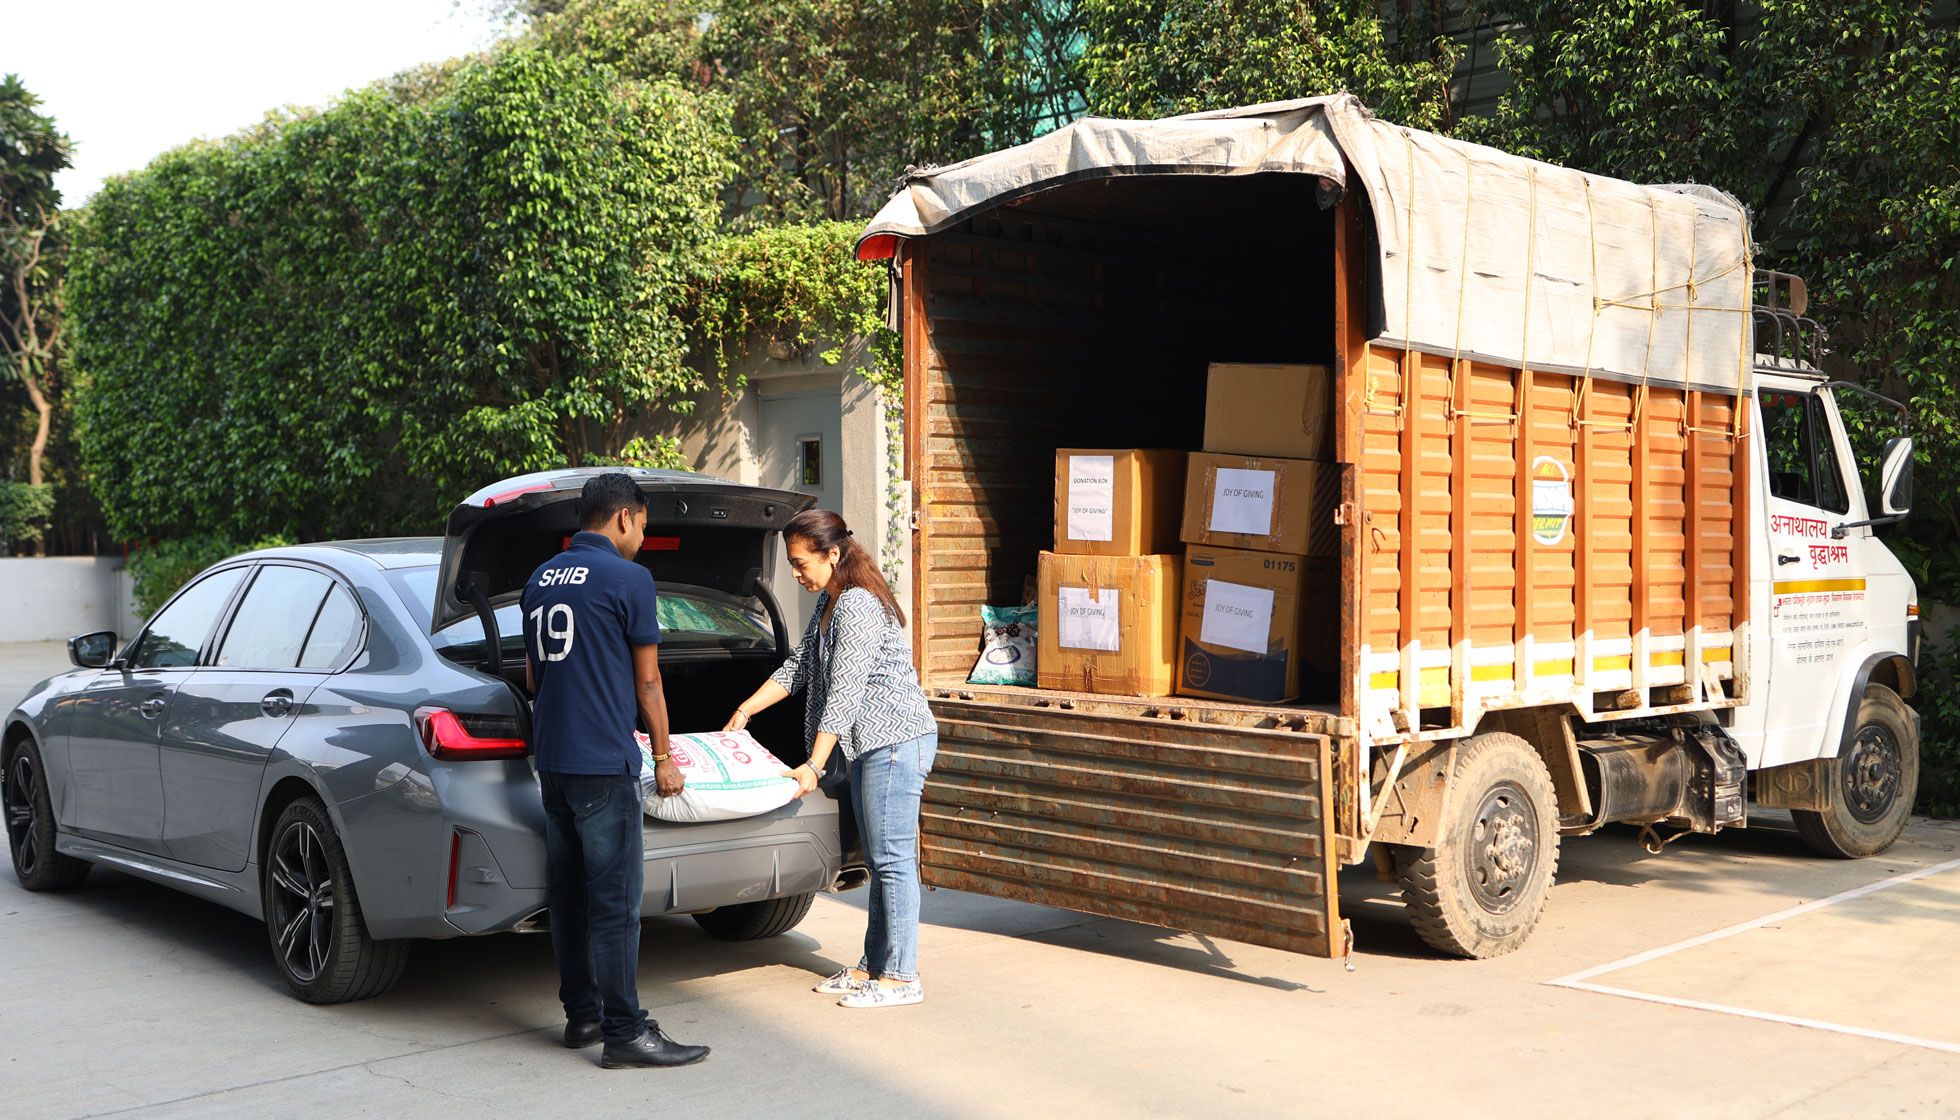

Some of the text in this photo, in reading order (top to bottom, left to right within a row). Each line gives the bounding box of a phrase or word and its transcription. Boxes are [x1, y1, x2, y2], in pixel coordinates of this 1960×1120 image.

[1223, 488, 1264, 499] JOY OF GIVING
[1533, 517, 1563, 530] ERMIT
[1771, 514, 1827, 538] अनाथालय
[1263, 559, 1296, 572] 01175
[1808, 545, 1848, 570] वृद्धाश्रम
[538, 566, 590, 587] SHIB
[1070, 607, 1105, 617] JOY OF GIVING
[1214, 603, 1225, 612] JOY
[1225, 605, 1234, 614] OF
[1234, 607, 1254, 619] GIVING
[529, 603, 575, 662] 19
